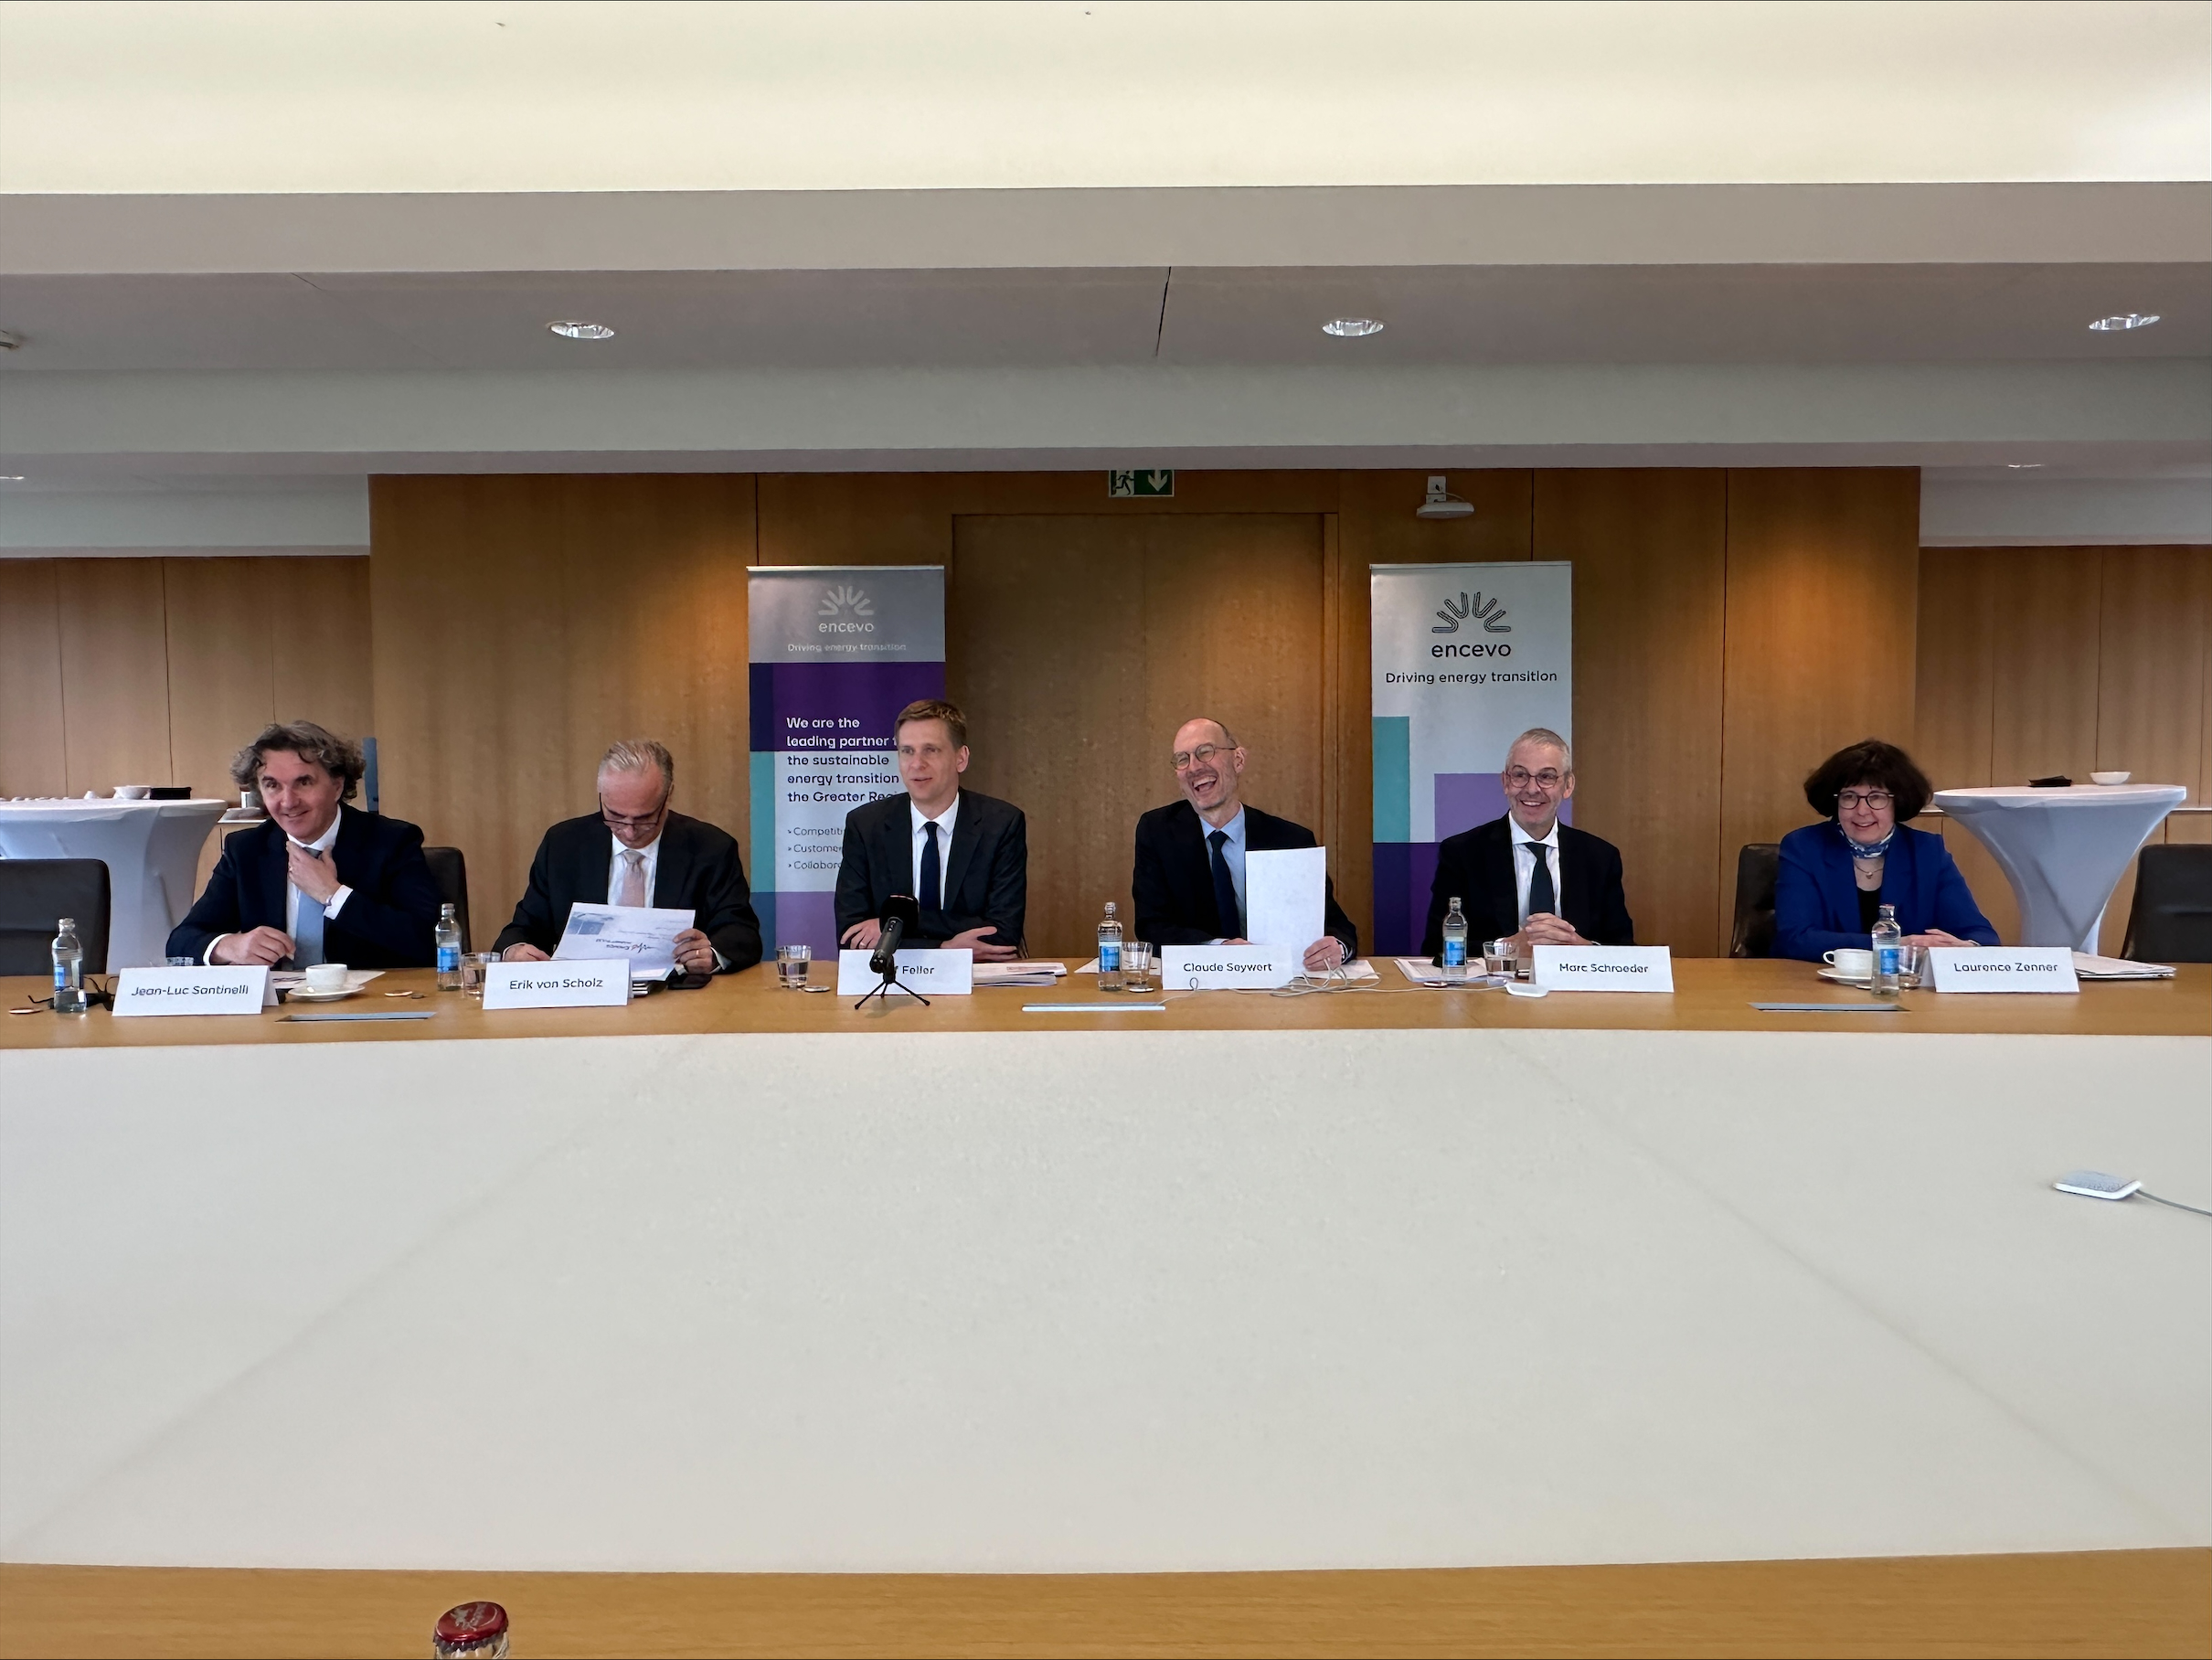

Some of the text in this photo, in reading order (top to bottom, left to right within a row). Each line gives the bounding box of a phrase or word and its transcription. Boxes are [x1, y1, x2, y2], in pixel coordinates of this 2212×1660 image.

[818, 622, 875, 633] encevo
[787, 644, 822, 653] Driving
[824, 644, 857, 653] energy
[1431, 643, 1512, 658] encevo
[1386, 670, 1558, 685] Driving energy transition
[786, 718, 860, 729] We are the
[787, 736, 836, 749] leading
[839, 737, 889, 749] partner
[787, 755, 889, 765] the sustainable
[787, 772, 899, 786] energy transition
[787, 792, 809, 802] the
[813, 792, 866, 802] Greater
[902, 965, 934, 974] Feller
[1183, 963, 1272, 974] Claude Seywert
[1559, 963, 1648, 973] Marc Schroeder
[1953, 963, 2058, 972] Laurence Zenner
[509, 977, 603, 990] Erik von Scholz
[131, 984, 249, 996] Jean-Luc Santinelli
